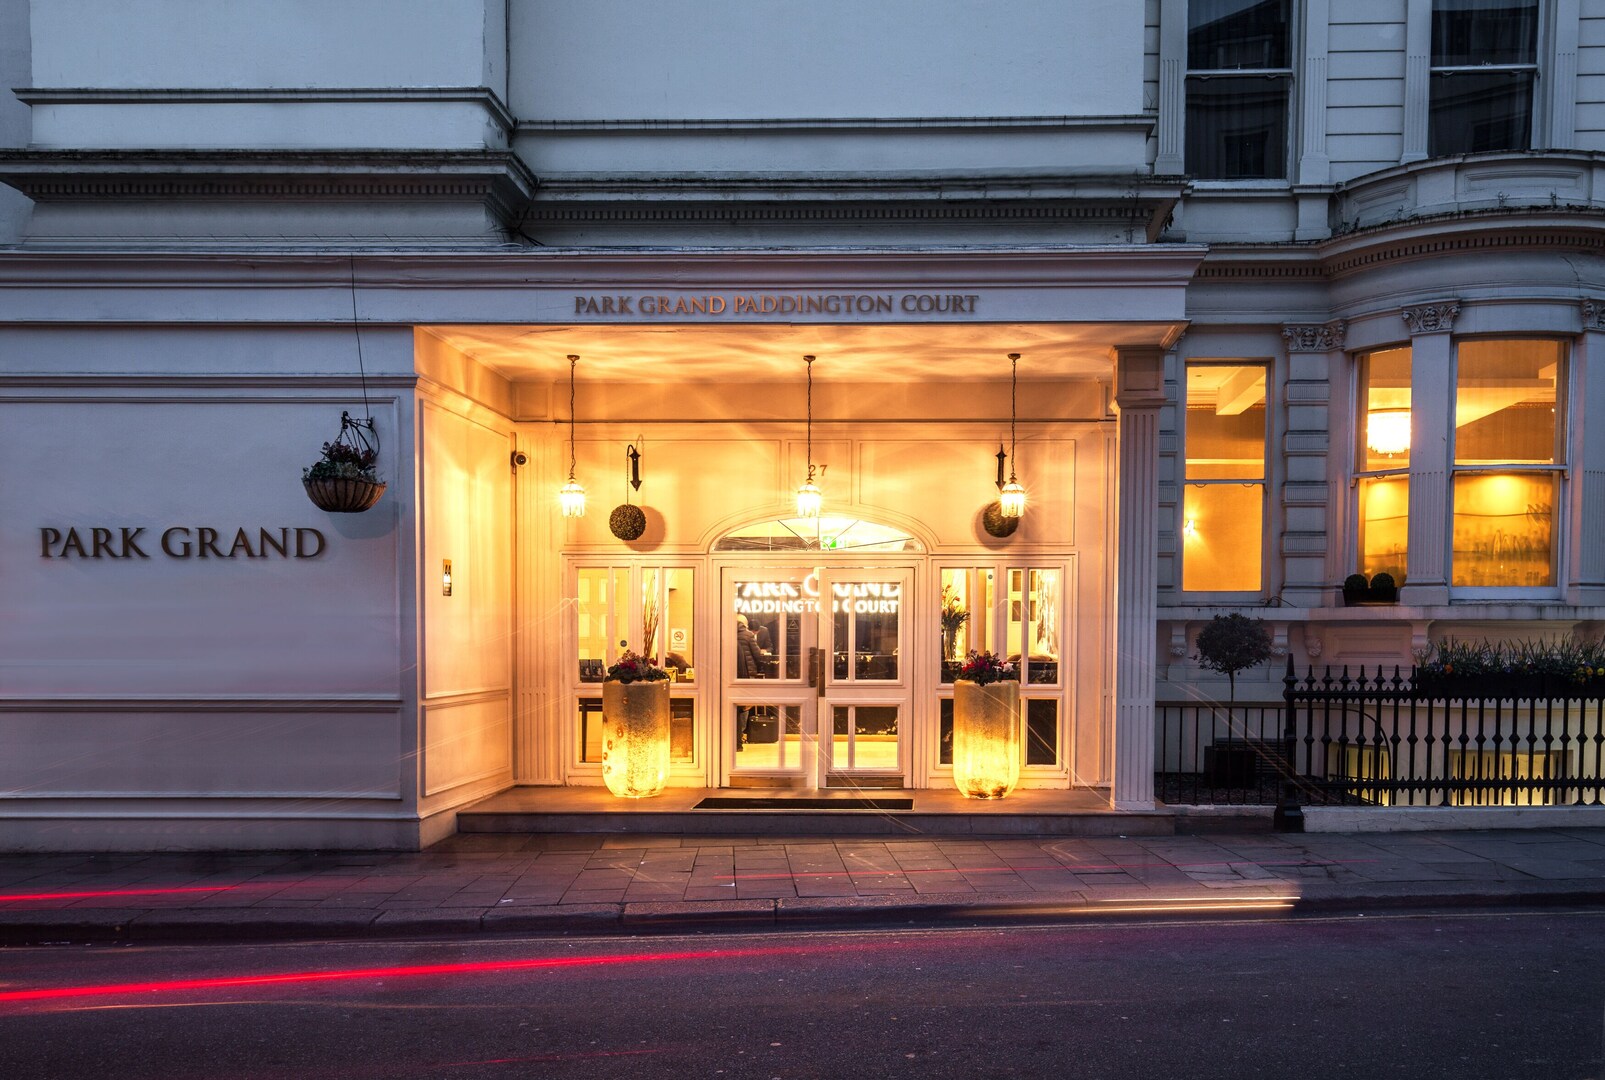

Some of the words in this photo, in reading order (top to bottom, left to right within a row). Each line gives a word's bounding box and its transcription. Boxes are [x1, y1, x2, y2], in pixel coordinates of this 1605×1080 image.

[575, 296, 635, 315] PARK
[639, 296, 727, 314] GRAND
[733, 296, 894, 314] PADDINGTON
[902, 294, 979, 313] COURT
[809, 464, 828, 477] 27
[39, 526, 150, 558] PARK
[160, 526, 327, 558] GRAND
[841, 598, 899, 613] COURT
